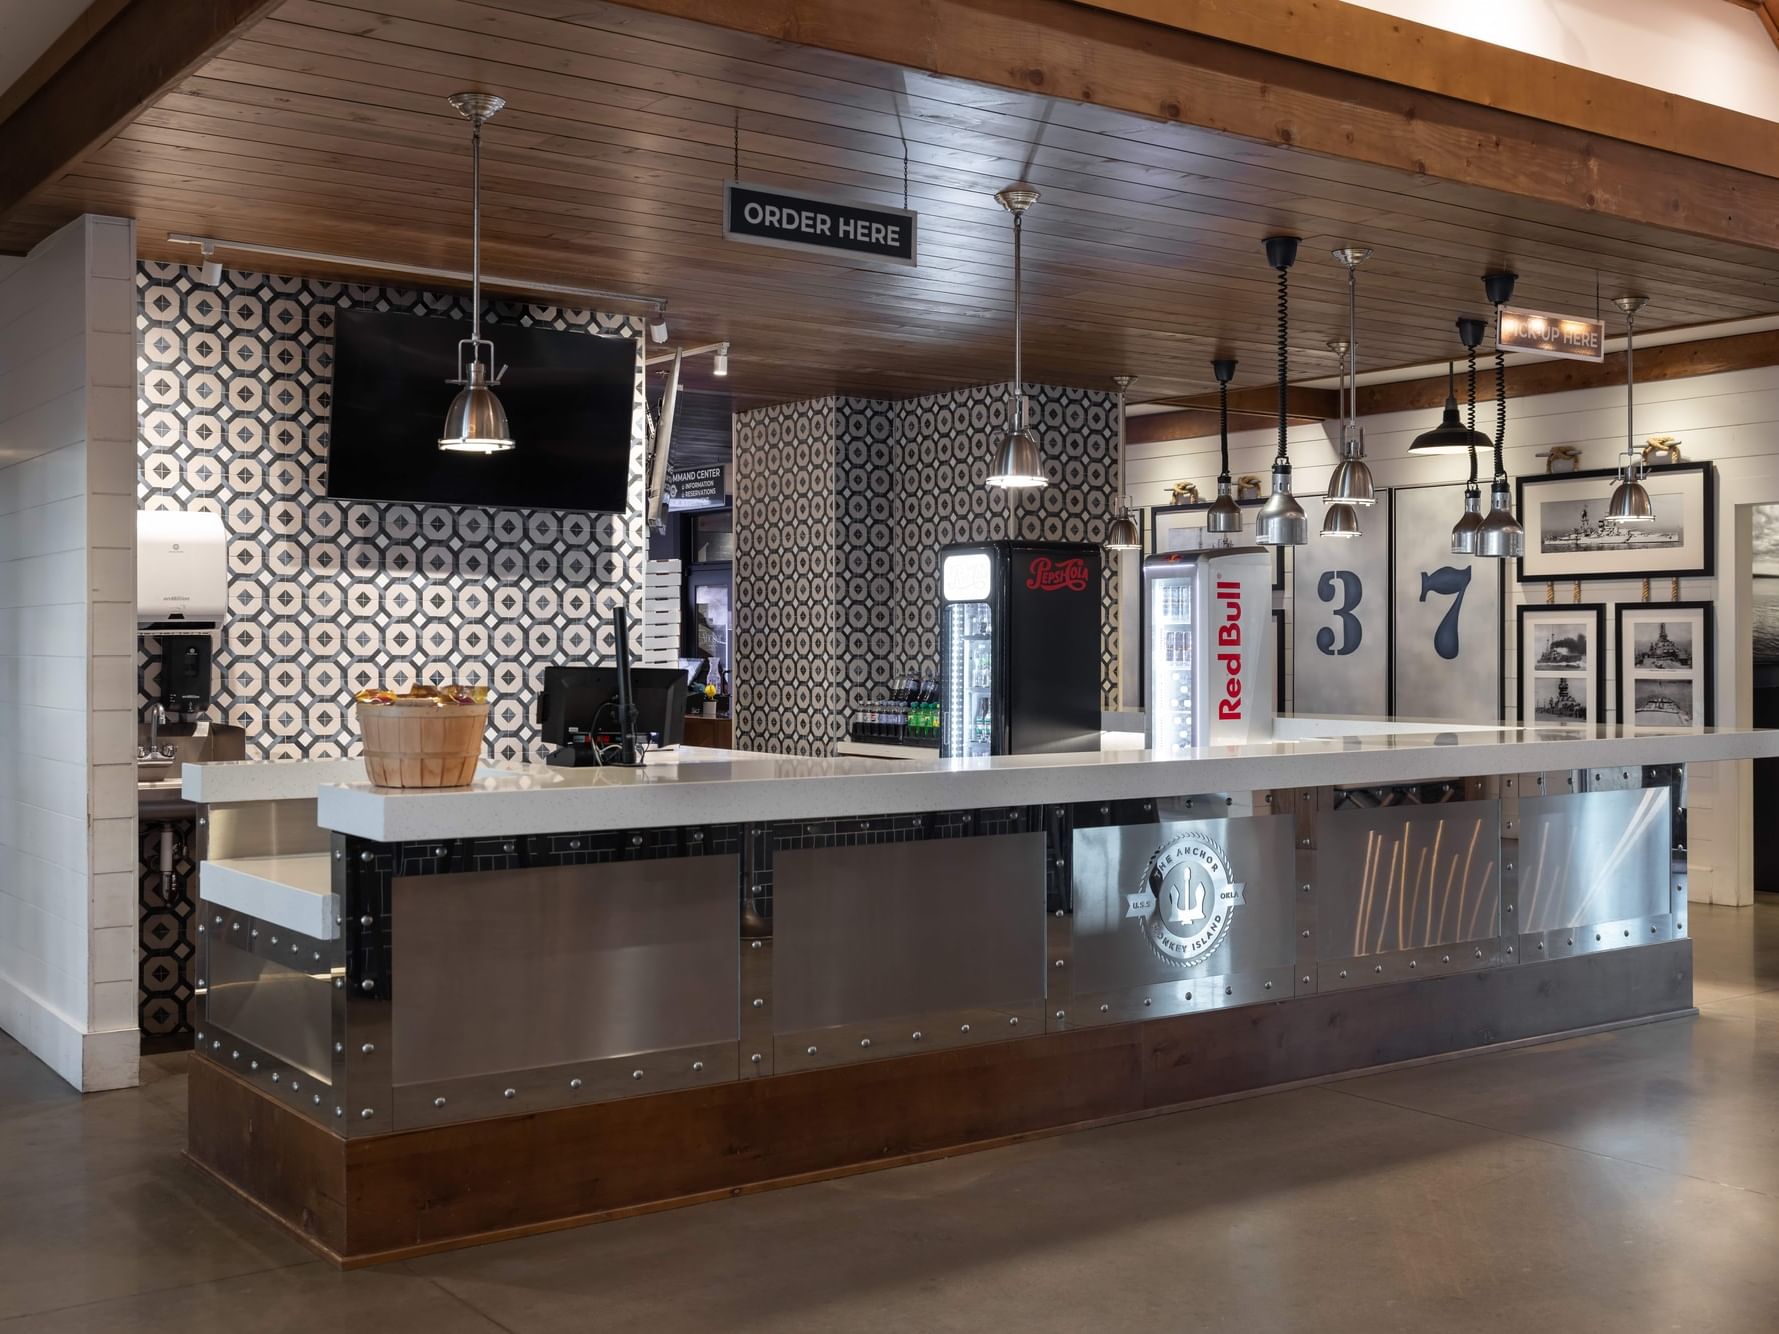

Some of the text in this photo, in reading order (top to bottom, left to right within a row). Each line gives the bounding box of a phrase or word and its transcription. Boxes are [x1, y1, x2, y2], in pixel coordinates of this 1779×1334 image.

[744, 202, 900, 247] ORDER HERE
[1508, 319, 1598, 348] ICK UP HERE
[673, 468, 721, 481] MMAND CENTER
[685, 480, 714, 489] INFORMATION
[685, 488, 716, 497] RESERVATIONS
[1316, 565, 1472, 660] 3 7
[1216, 581, 1242, 720] Red Bull
[1154, 846, 1219, 877] THE ANCHOR
[1153, 915, 1221, 953] ONKEY ISLAND
